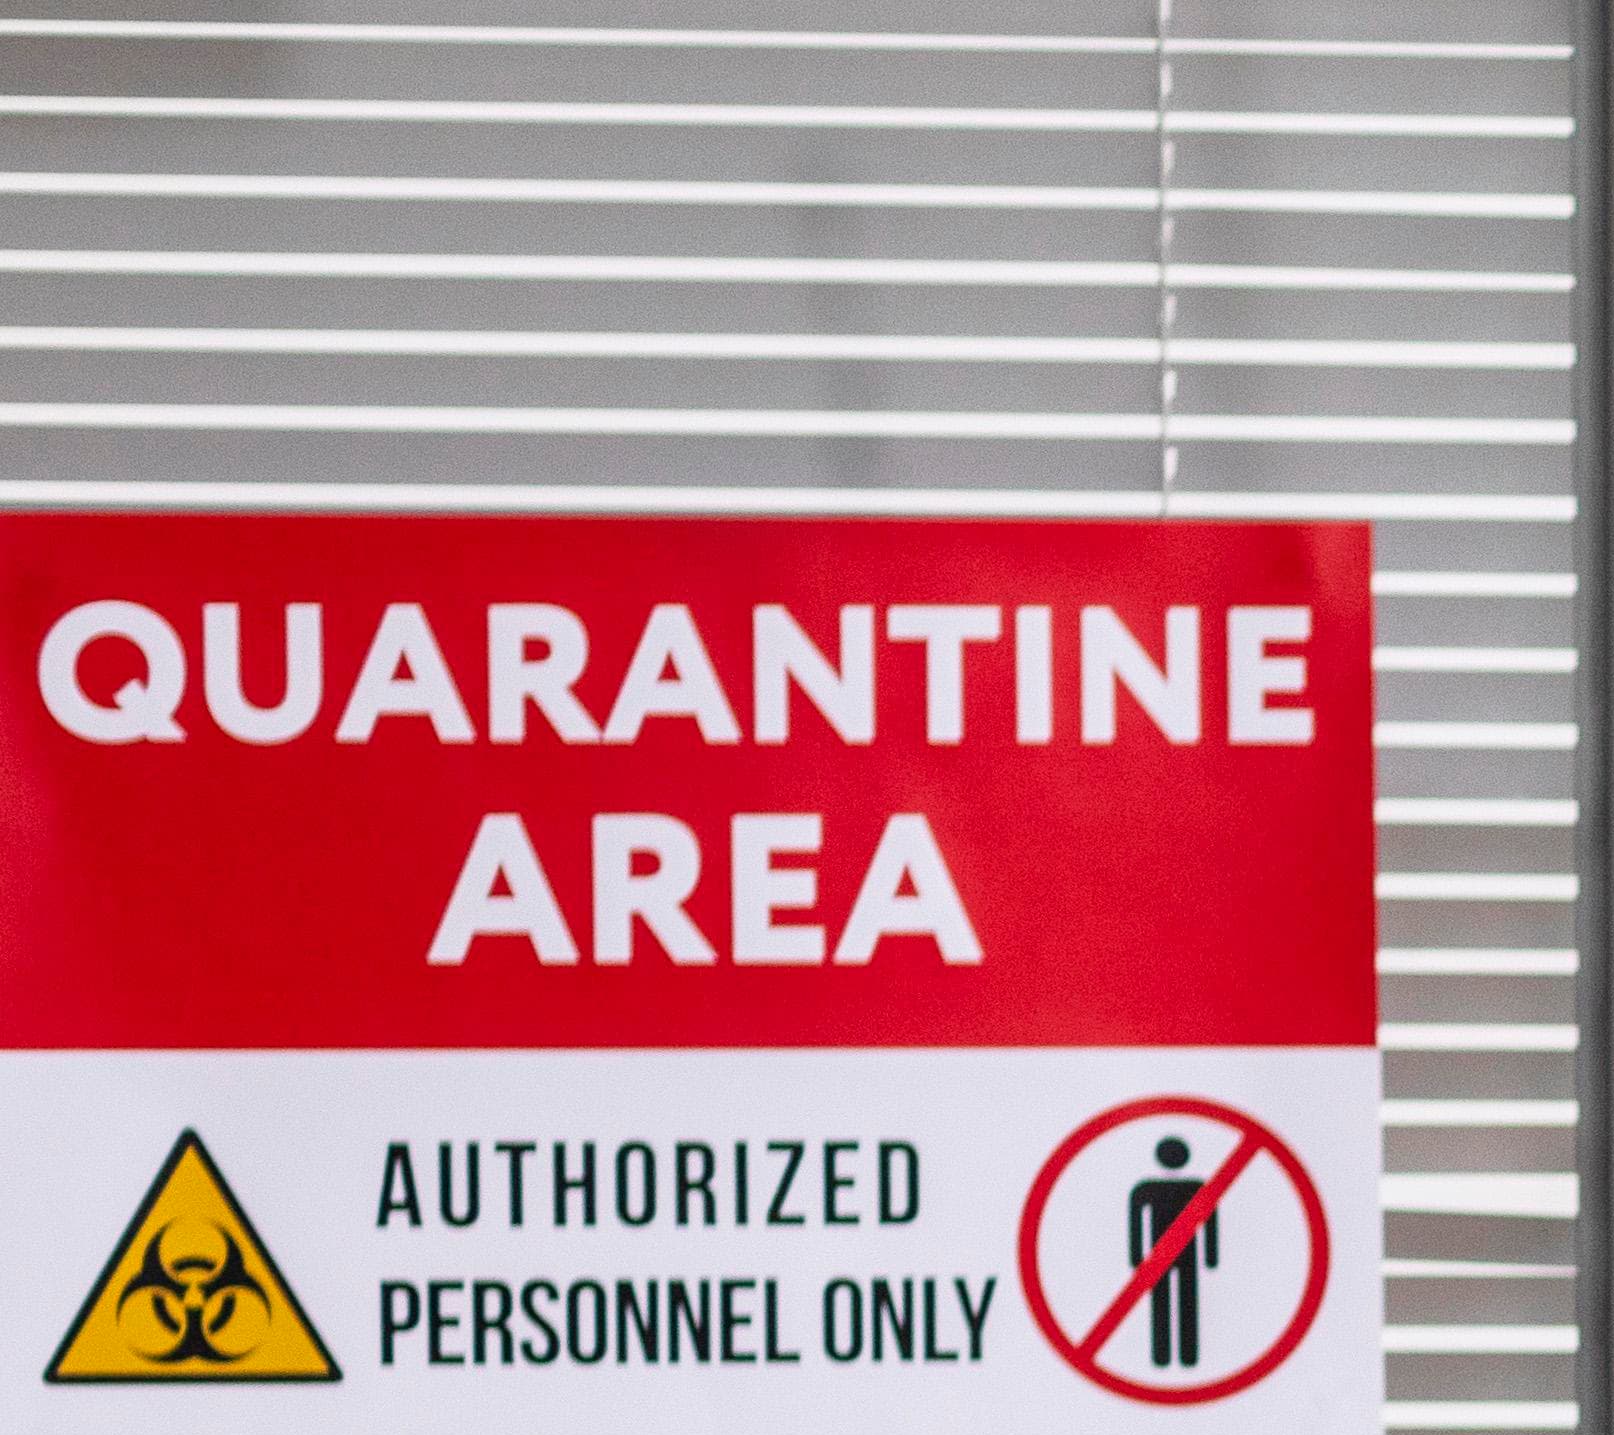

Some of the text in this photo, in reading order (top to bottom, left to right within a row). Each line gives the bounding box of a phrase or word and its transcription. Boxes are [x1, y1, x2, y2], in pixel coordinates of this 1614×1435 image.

[38, 600, 1316, 746] QUARANTINE
[427, 812, 986, 967] AREA
[376, 1140, 923, 1231] AUTHORIZED
[379, 1277, 999, 1368] PERSONNEL ONLY
